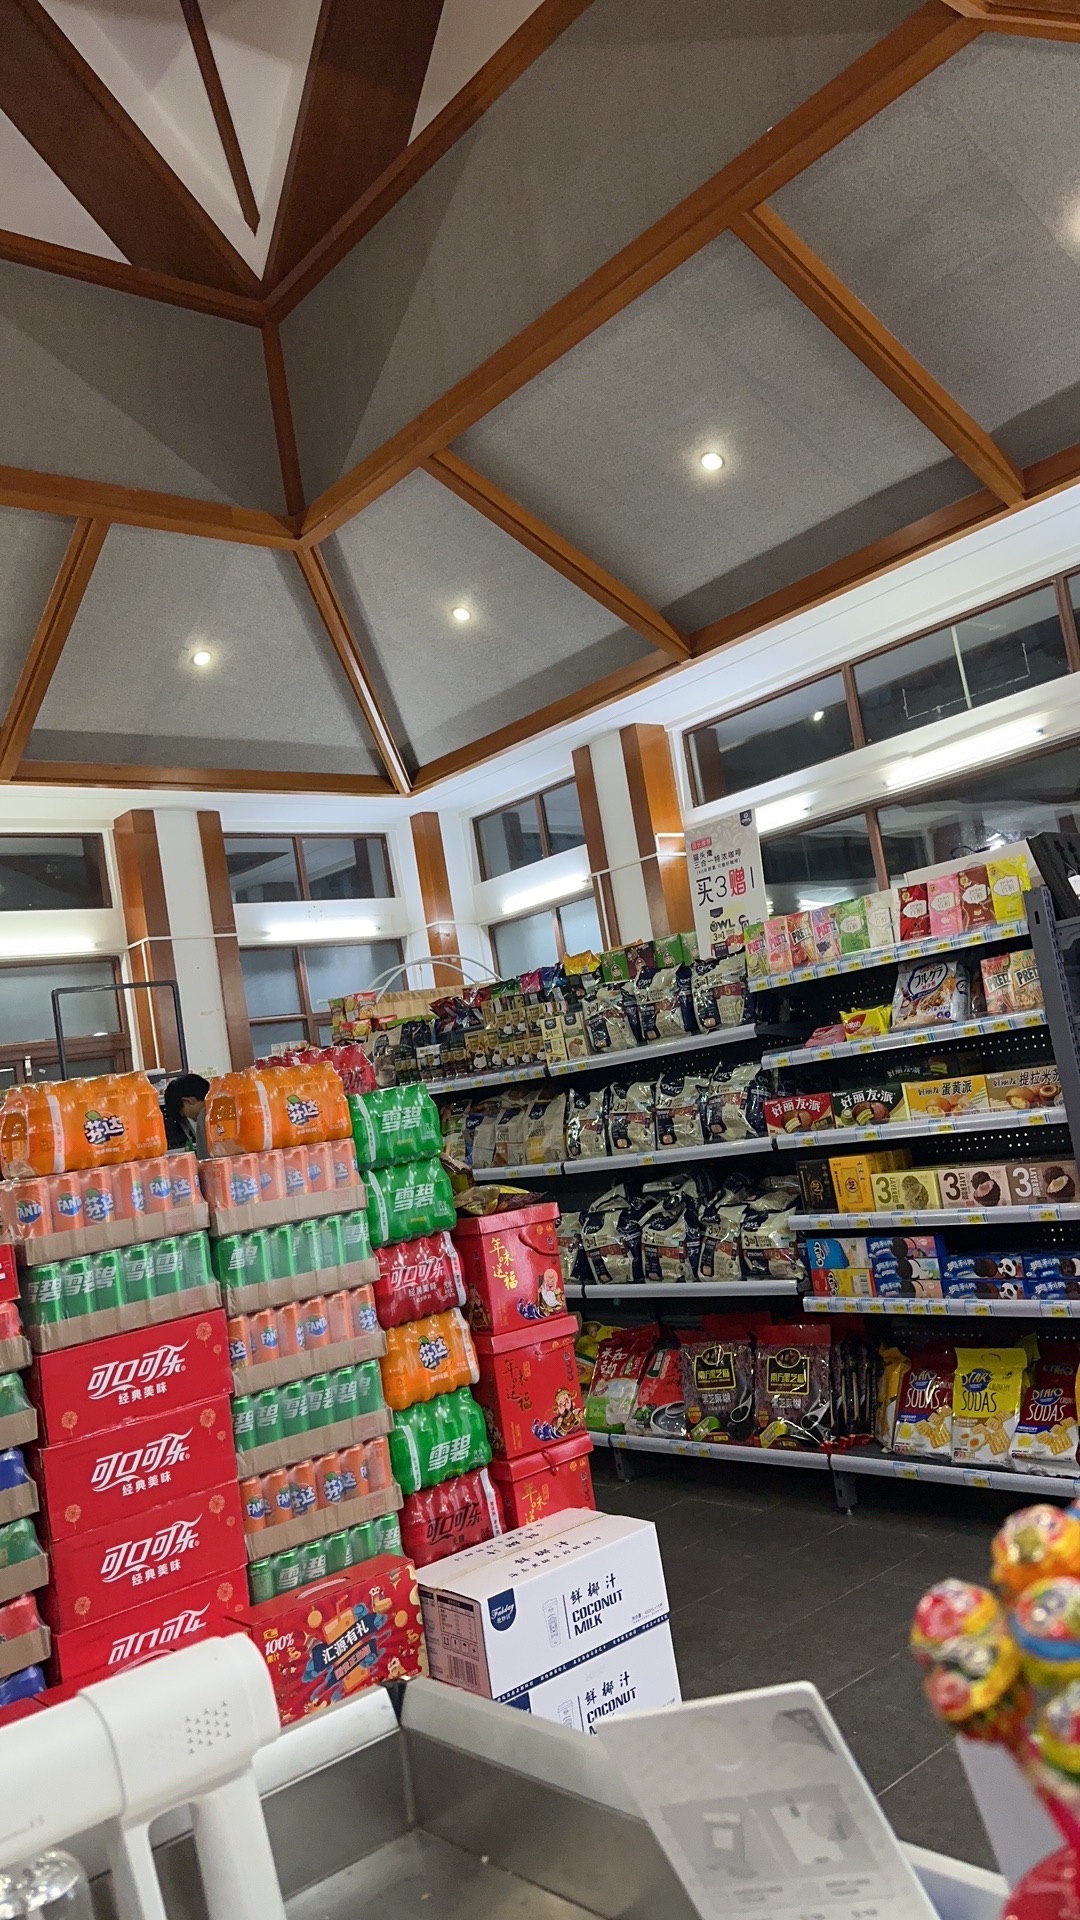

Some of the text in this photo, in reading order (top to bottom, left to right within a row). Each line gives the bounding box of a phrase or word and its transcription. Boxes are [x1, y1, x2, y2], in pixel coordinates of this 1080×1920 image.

[709, 917, 735, 932] OWL
[791, 928, 812, 944] PRETZ
[816, 922, 837, 938] PRETZ
[747, 939, 766, 955] PRETZ
[768, 934, 788, 950] PRETZ
[914, 968, 944, 987] フルグラ
[986, 971, 1012, 991] PRETZ
[840, 1088, 894, 1110] 好丽友·派
[941, 1079, 973, 1096] 蛋黄派
[286, 1099, 320, 1125] 芬达
[380, 1105, 422, 1134] 雪碧
[771, 1097, 821, 1118] 好丽友·派
[85, 1114, 124, 1145] 芬达
[875, 1176, 892, 1204] 3
[943, 1172, 961, 1201] 3
[1012, 1167, 1032, 1198] 3
[57, 1196, 82, 1212] FANT
[85, 1192, 114, 1217] 芬达
[393, 1182, 435, 1213] 雪碧
[16, 1203, 43, 1219] FANTA
[390, 1255, 445, 1292] 可口可乐
[488, 1237, 519, 1291] 年味送福
[261, 1329, 278, 1346] FAN
[419, 1336, 448, 1369] 芬达
[86, 1338, 190, 1400] 可口可乐
[697, 1368, 730, 1380] 南方黑芝麻
[770, 1372, 805, 1384] 南方黑芝麻
[118, 1381, 168, 1406] 经典美味
[502, 1359, 533, 1412] 年味送福
[701, 1392, 732, 1404] 黑芝麻糊
[961, 1391, 998, 1413] SODAS
[1026, 1403, 1065, 1422] SODAS
[90, 1427, 194, 1493] 可口可乐
[427, 1434, 471, 1472] 雪碧
[122, 1471, 172, 1498] 经典美味
[246, 1498, 264, 1516] FAN
[426, 1502, 481, 1546] 可口可乐
[100, 1513, 203, 1584] 可口可乐
[452, 1534, 465, 1547] 无糖
[514, 1540, 569, 1565] 鲜椰汁
[131, 1559, 182, 1587] 经典美味
[569, 1573, 616, 1605] 鲜椰汁
[571, 1589, 623, 1623] COCONUT
[573, 1614, 603, 1637] MILK
[265, 1631, 295, 1657] 100%
[321, 1619, 370, 1665] 汇源有礼
[266, 1654, 280, 1667] 果汁
[584, 1671, 630, 1706] 鲜椰汁
[586, 1687, 637, 1724] COCONUT
